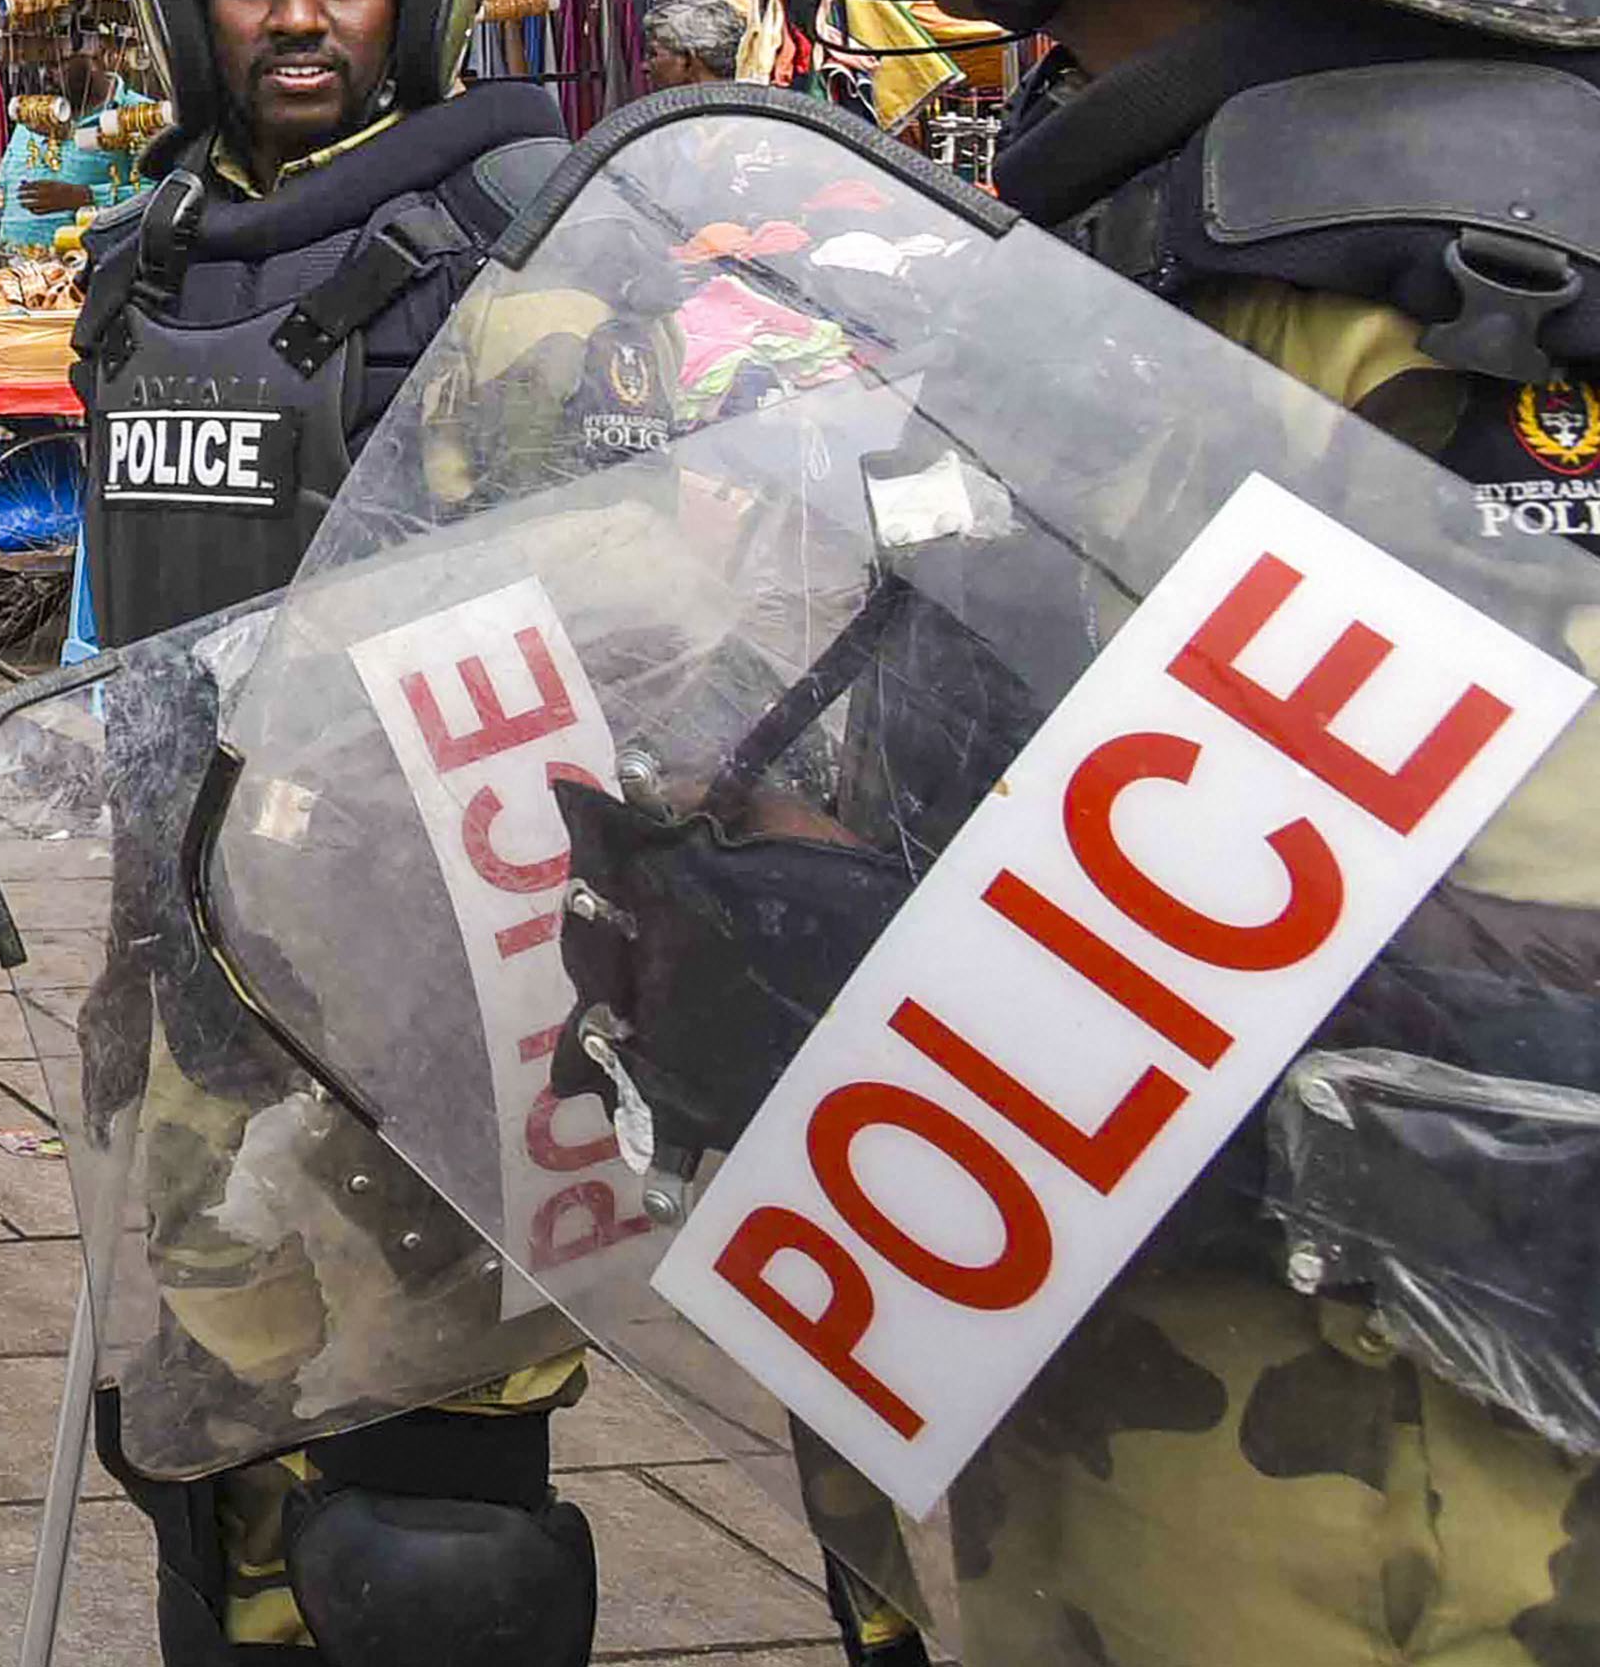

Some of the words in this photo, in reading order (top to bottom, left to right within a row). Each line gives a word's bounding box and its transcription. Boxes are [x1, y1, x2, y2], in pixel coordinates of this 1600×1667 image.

[108, 420, 262, 487] POLICE
[1475, 479, 1600, 502] HYDERABA
[1476, 501, 1600, 537] POLI
[714, 551, 1512, 1442] POLICE
